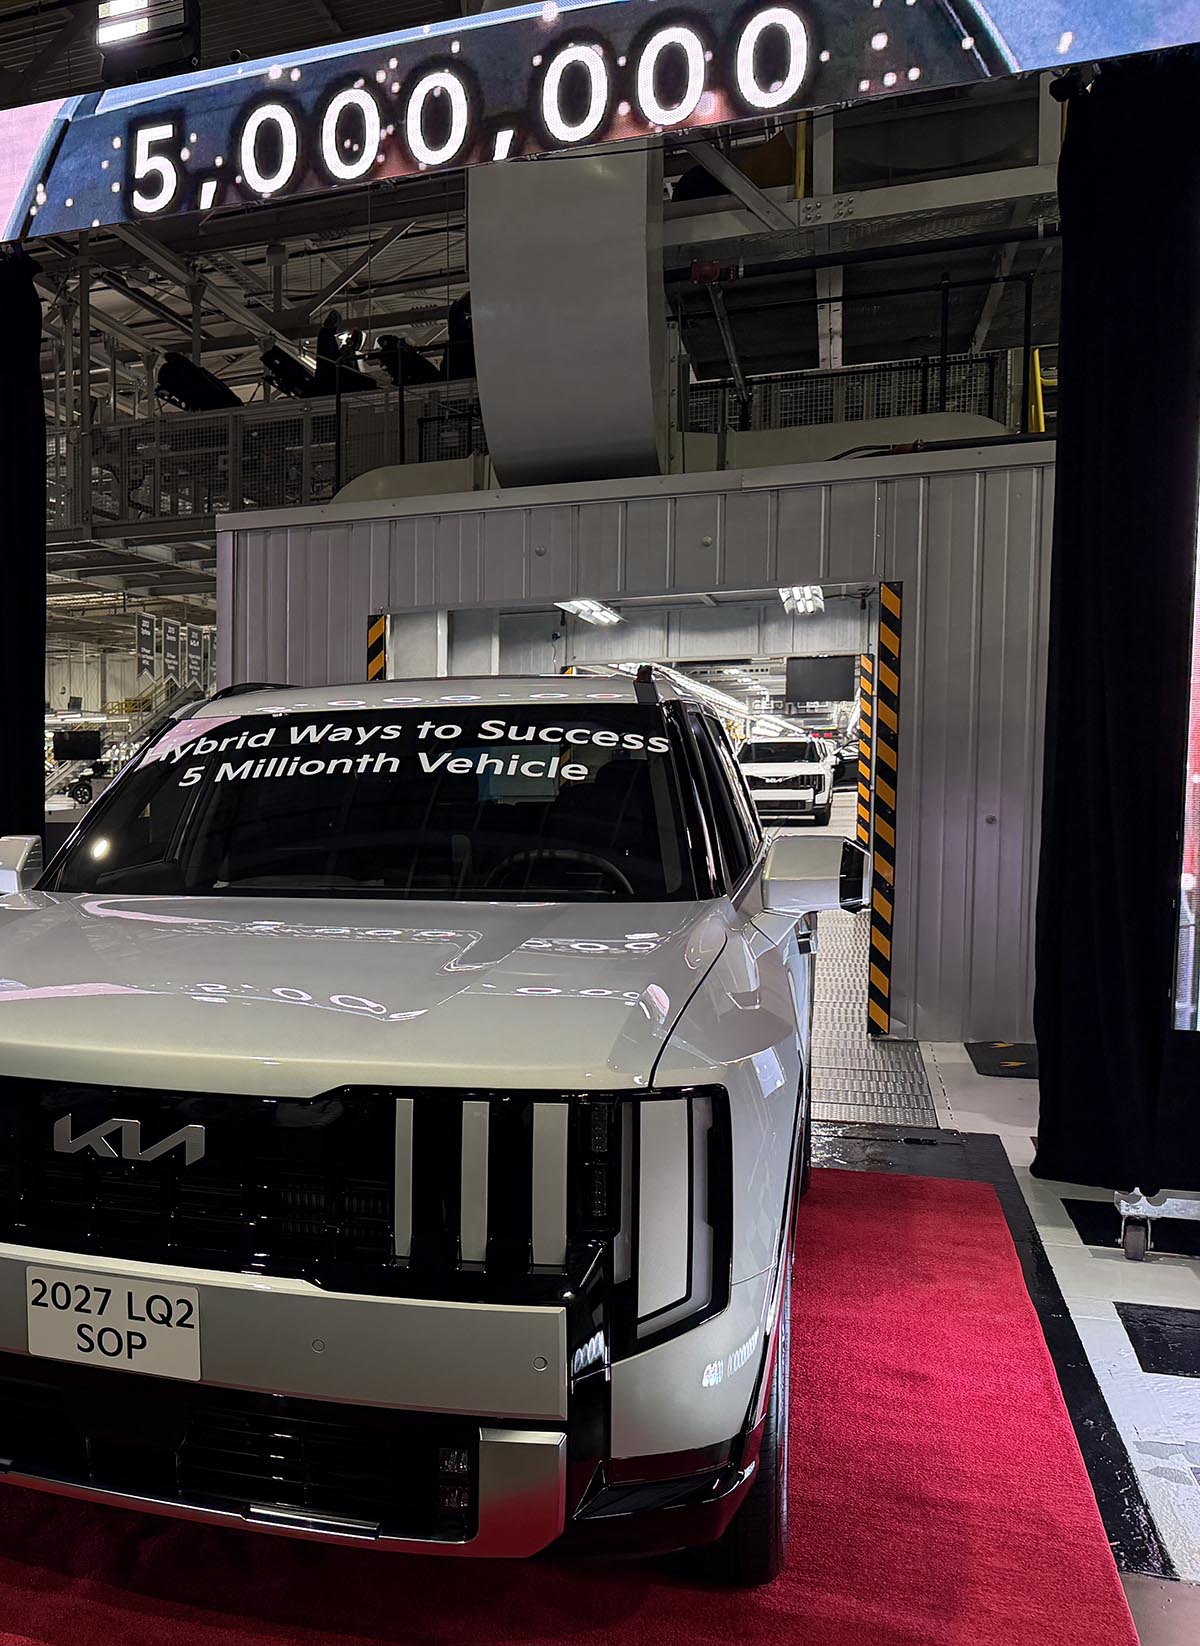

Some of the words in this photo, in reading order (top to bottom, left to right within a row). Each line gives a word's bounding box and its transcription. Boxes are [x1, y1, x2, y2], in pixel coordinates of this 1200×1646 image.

[131, 6, 809, 214] 5,000,000
[143, 727, 277, 765] Hybrid
[289, 722, 403, 746] Ways
[416, 720, 463, 740] to
[477, 719, 671, 754] Success
[178, 765, 206, 788] 5
[213, 752, 401, 784] Millionth
[417, 751, 590, 782] Vehicle
[53, 1112, 206, 1167] KIA
[30, 1278, 112, 1317] 2027
[126, 1290, 196, 1329] LQ2
[76, 1323, 147, 1360] SOP
